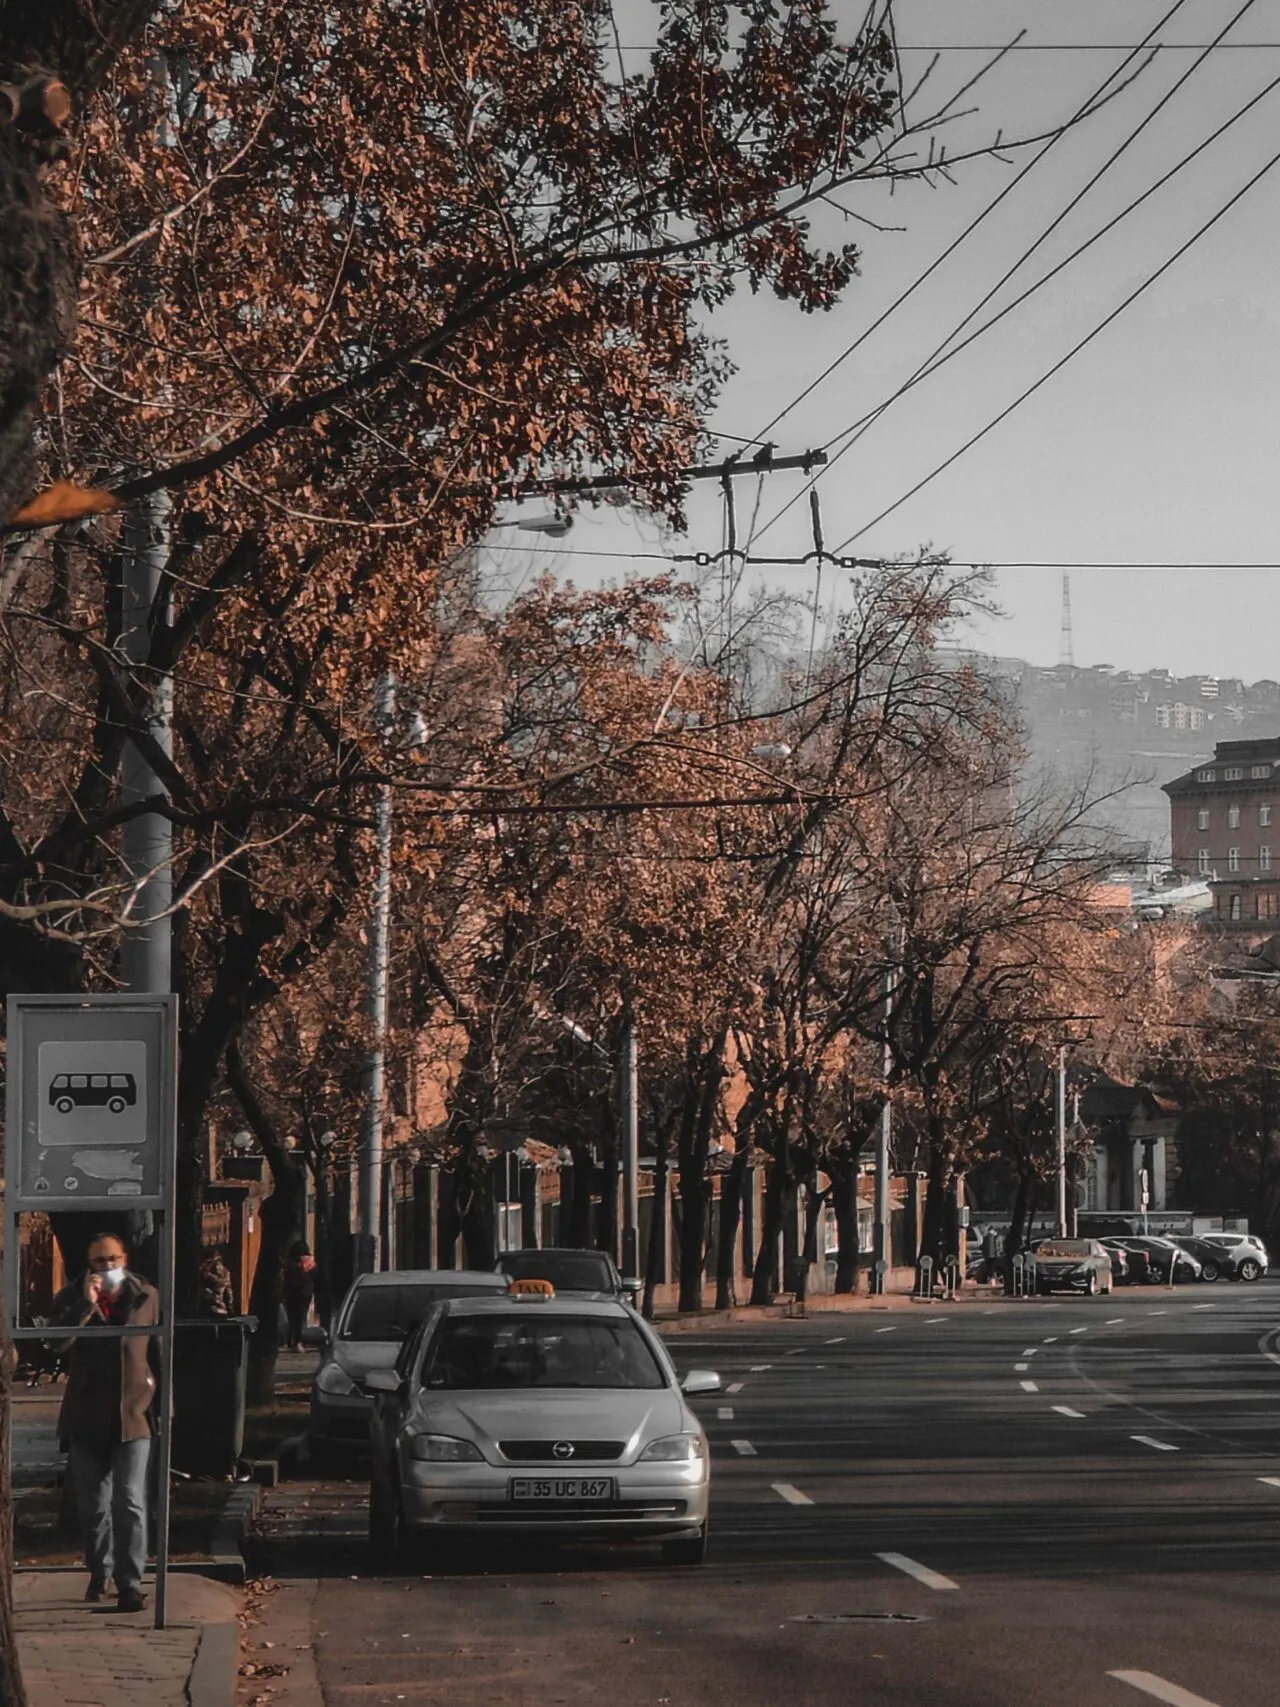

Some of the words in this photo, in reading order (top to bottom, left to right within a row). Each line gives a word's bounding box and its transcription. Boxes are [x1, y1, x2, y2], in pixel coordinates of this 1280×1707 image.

[517, 1283, 546, 1294] TAXI
[533, 1481, 551, 1497] 35
[555, 1481, 576, 1497] UC
[580, 1481, 608, 1497] 867
